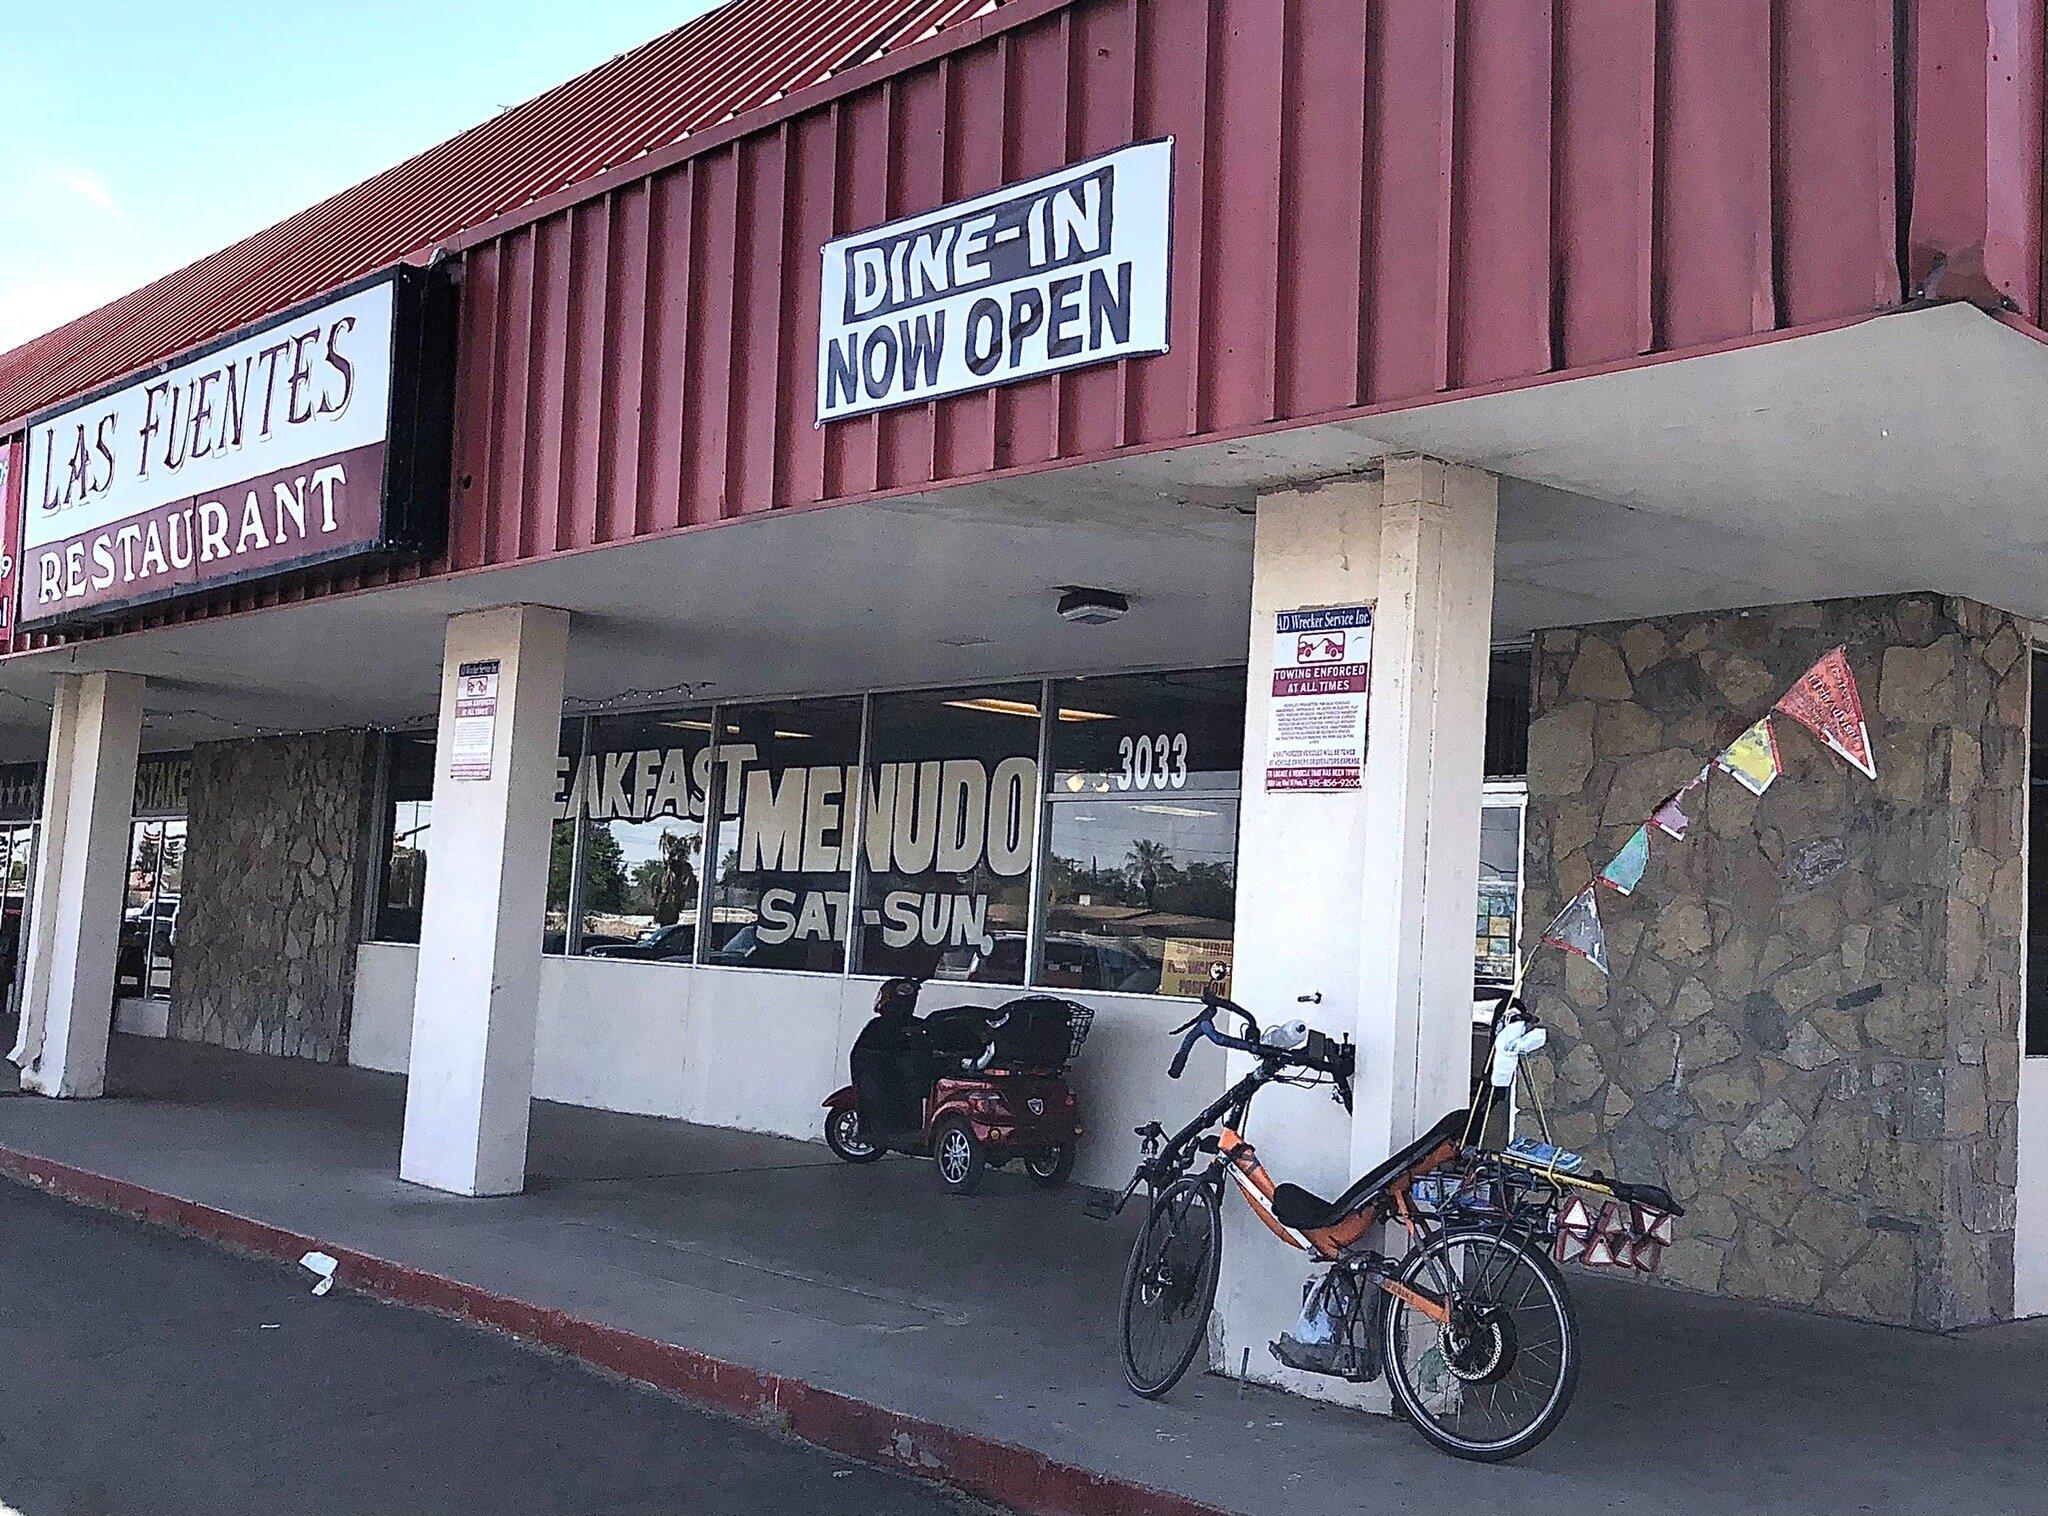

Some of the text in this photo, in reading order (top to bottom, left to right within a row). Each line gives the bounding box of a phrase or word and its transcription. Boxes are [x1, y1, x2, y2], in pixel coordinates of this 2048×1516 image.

[854, 178, 1100, 316] DINE-IN
[826, 261, 1132, 409] NOW OPEN
[41, 316, 356, 512] LAS FUENTES
[38, 463, 347, 604] RESTAURANT
[1274, 664, 1365, 680] TOWING ENFORCED
[1291, 613, 1323, 629] Wrecker
[1324, 611, 1354, 628] Service
[1287, 680, 1350, 693] AT ALL TIMES
[739, 757, 1038, 876] MENUDO
[1117, 733, 1187, 791] 3033
